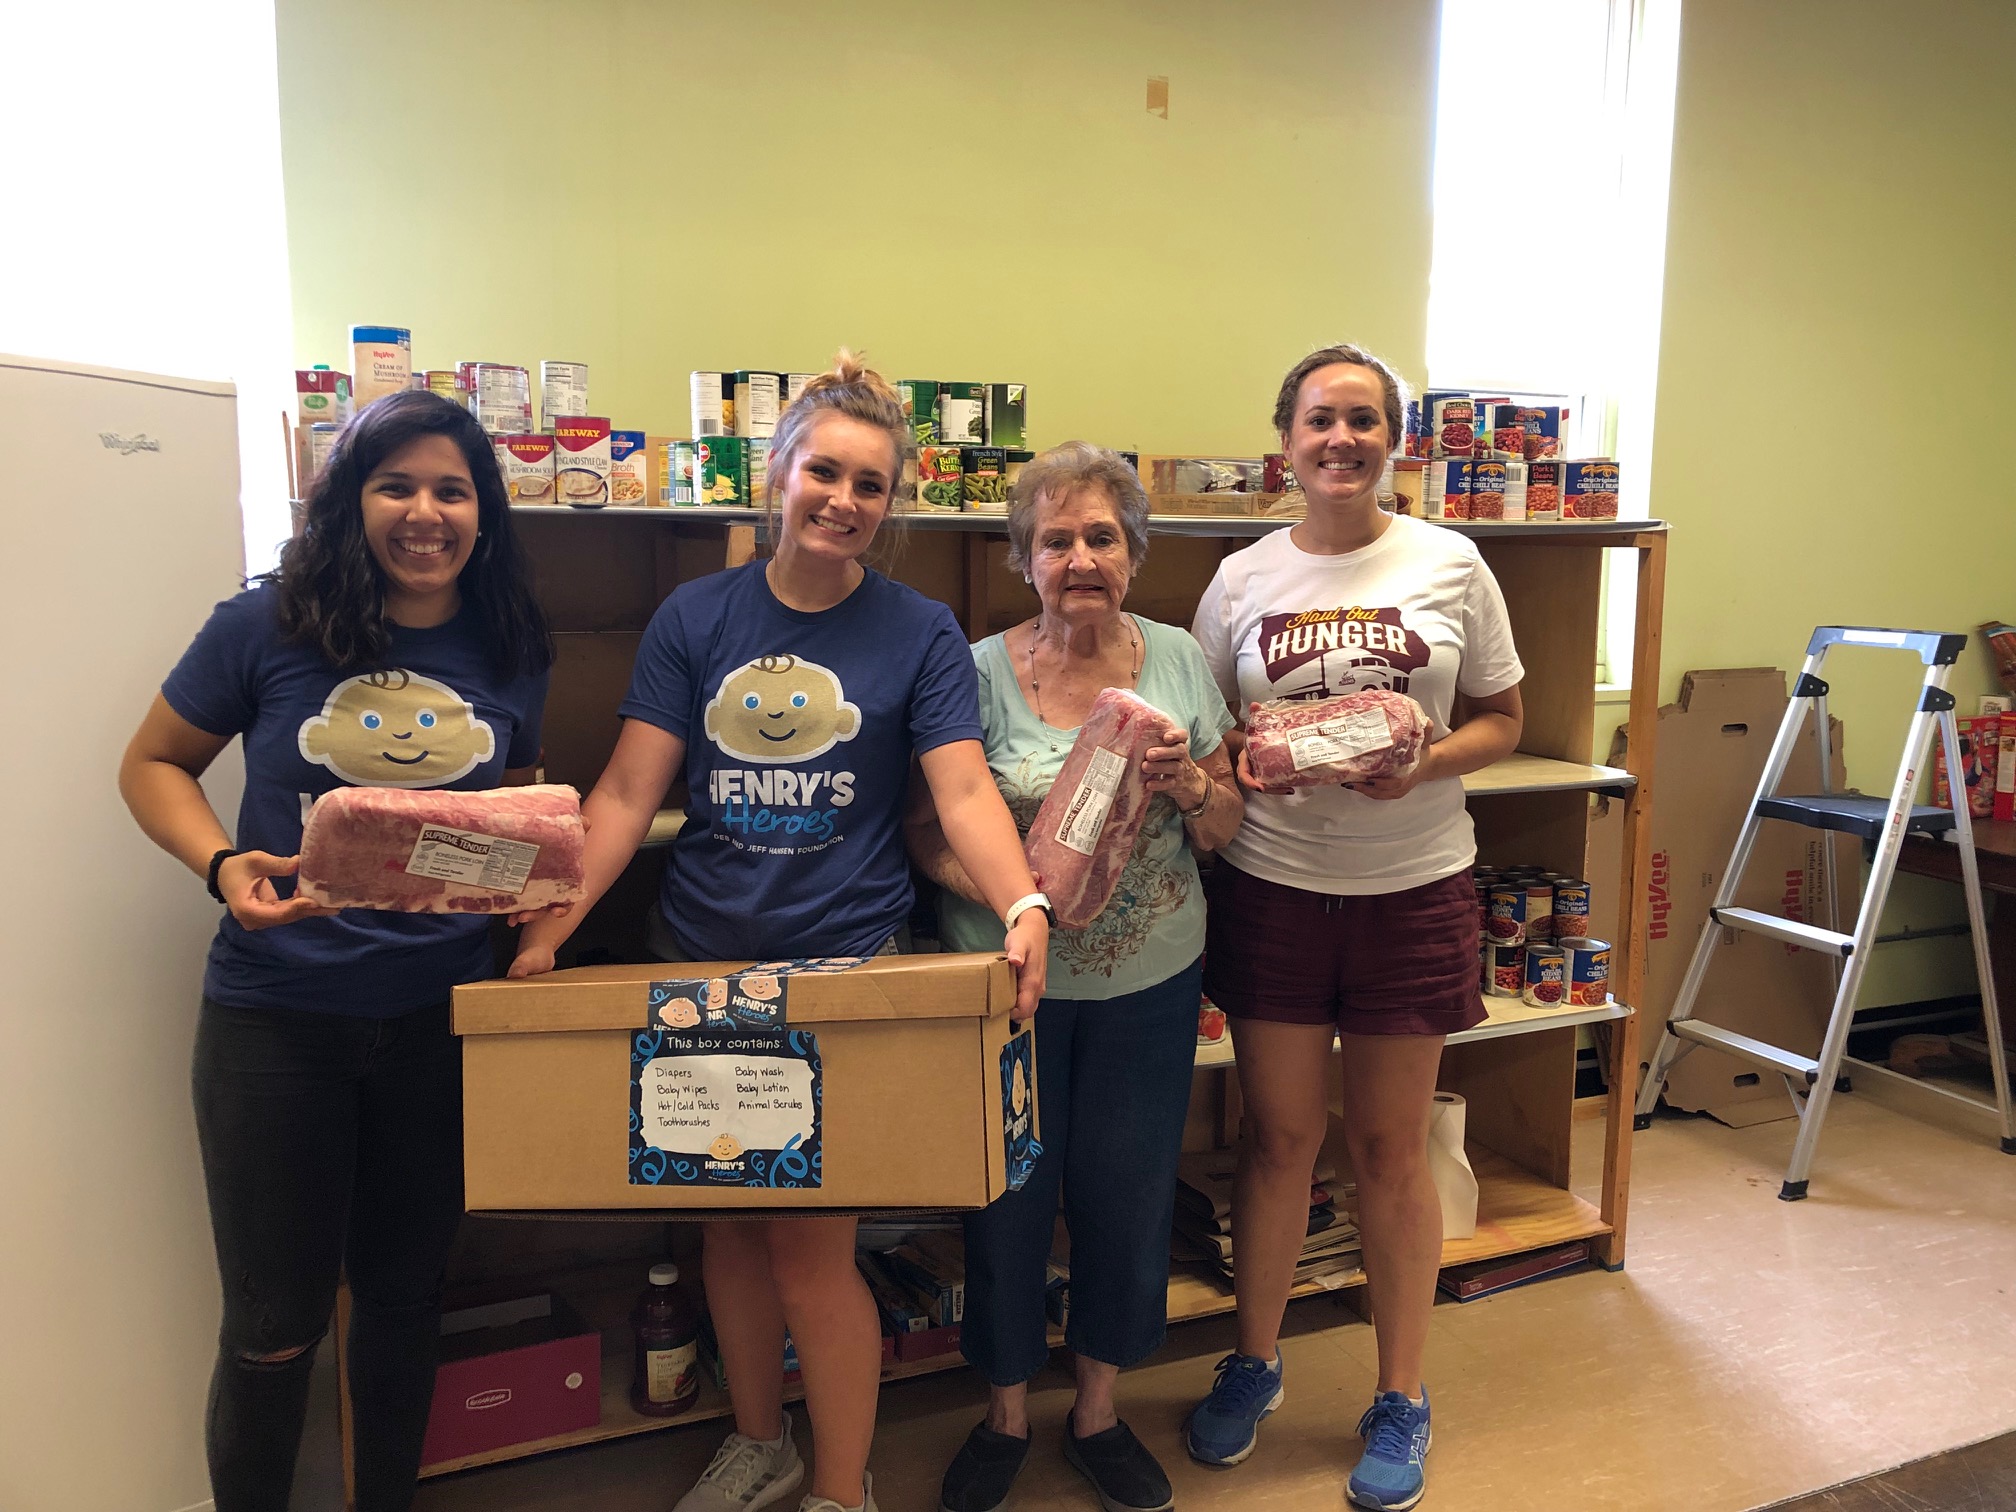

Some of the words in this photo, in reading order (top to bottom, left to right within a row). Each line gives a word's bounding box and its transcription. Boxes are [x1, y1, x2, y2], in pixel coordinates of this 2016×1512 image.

[556, 428, 600, 438] FAREWAY
[511, 444, 550, 452] FAREWAY
[612, 463, 635, 472] Broth
[977, 457, 998, 465] Green
[1533, 464, 1549, 472] Pork
[1286, 606, 1344, 629] Haul
[1346, 606, 1381, 621] Out
[1266, 621, 1412, 666] HUNGER
[1290, 728, 1319, 740] SUPREME
[1320, 724, 1346, 736] TENDER
[709, 769, 857, 807] HENRY'S
[721, 794, 839, 841] Heroes
[1060, 812, 1077, 840] SUPREME
[1072, 788, 1091, 812] TENDER
[424, 831, 459, 845] SUPREME
[459, 839, 489, 854] TENDER
[713, 833, 730, 841] DEB
[746, 844, 767, 854] JEFF
[1648, 852, 1672, 940] HyVee
[732, 995, 778, 1015] HENRY'S
[737, 1006, 772, 1023] Heroes
[667, 1037, 692, 1050] This
[698, 1037, 722, 1050] box
[727, 1037, 784, 1050] contains:
[655, 1067, 692, 1079] Diapers
[735, 1066, 759, 1080] Baby
[657, 1085, 681, 1098] Baby
[682, 1085, 708, 1097] Wipes
[736, 1084, 759, 1097] Baby
[762, 1083, 790, 1094] Lotion
[657, 1101, 695, 1112] Hot/Cold
[698, 1101, 720, 1111] Packs
[738, 1100, 771, 1110] Animal
[773, 1099, 803, 1110] Scrubs
[657, 1117, 711, 1127] Toothbrushes
[704, 1160, 746, 1171] HENRY'S
